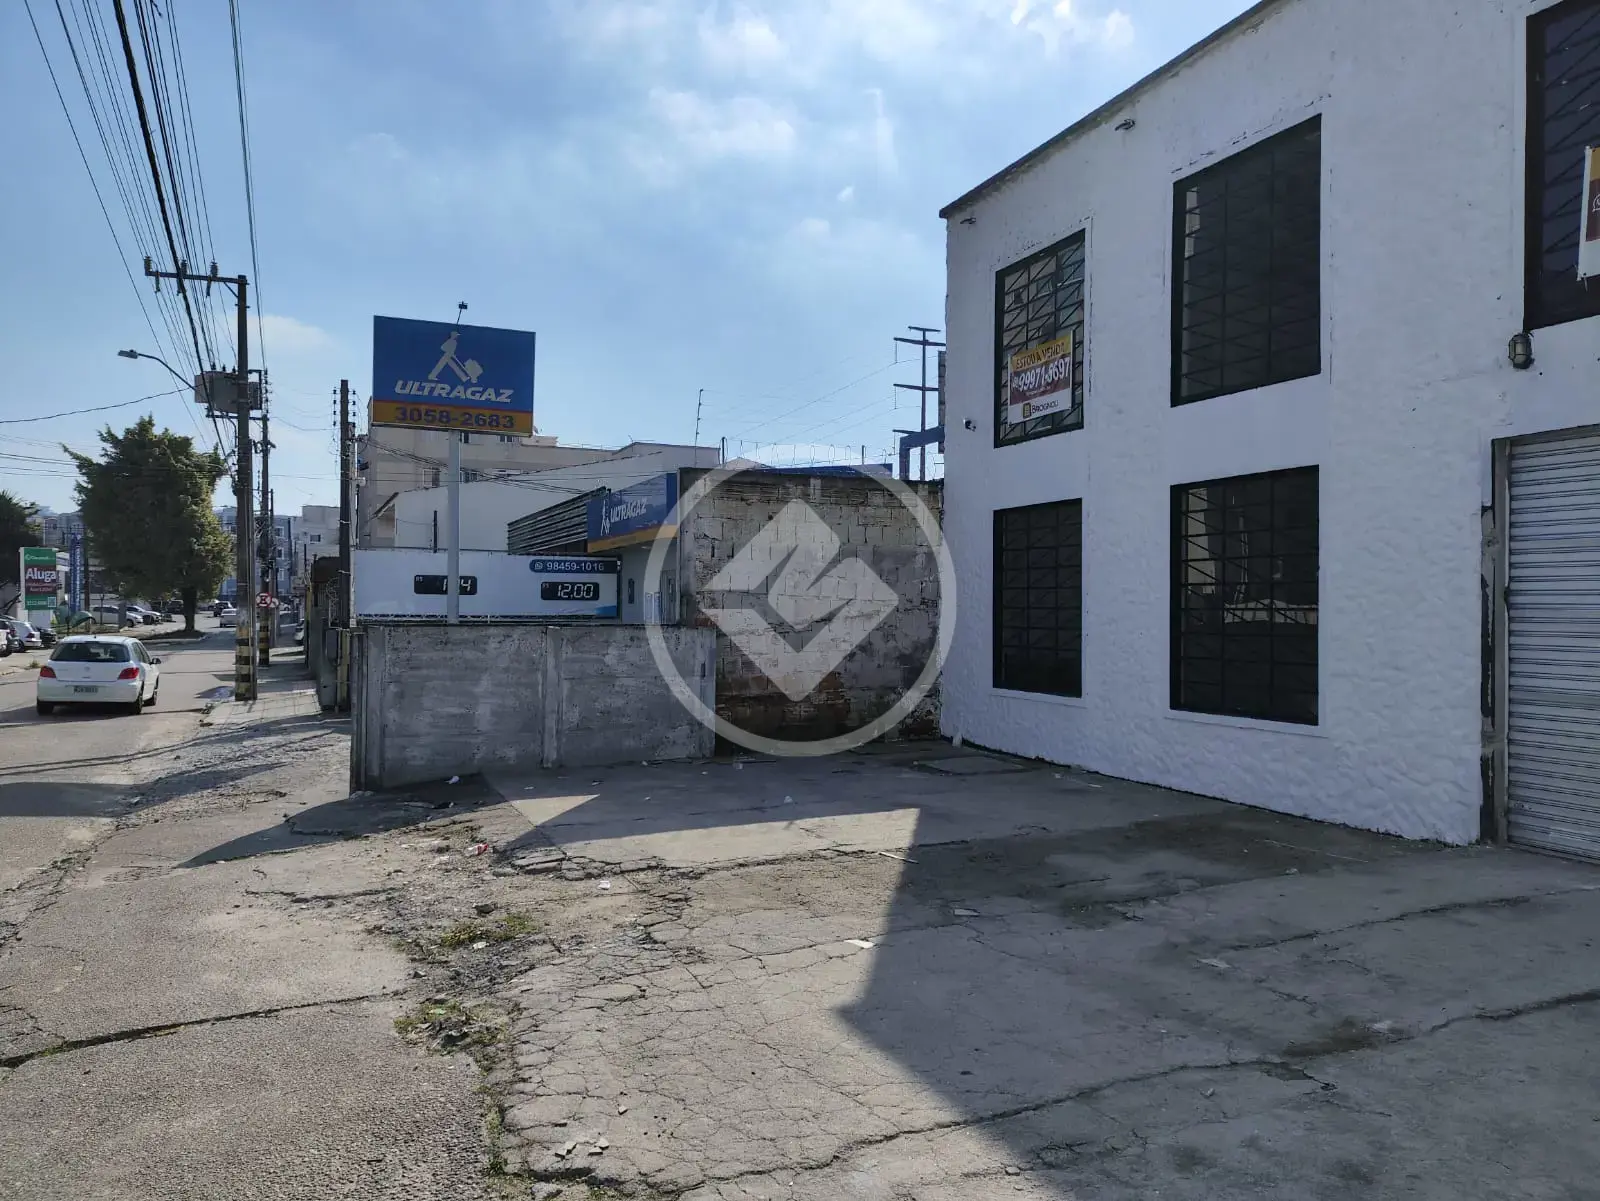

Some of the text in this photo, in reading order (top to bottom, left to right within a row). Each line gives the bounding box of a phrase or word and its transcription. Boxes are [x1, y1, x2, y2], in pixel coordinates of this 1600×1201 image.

[1016, 354, 1036, 369] ESTOU
[395, 380, 514, 403] ULTRAGAZ
[395, 406, 515, 429] 3058-2683
[610, 497, 648, 523] ULTRAGAZ
[546, 561, 605, 571] 98459-1016
[25, 567, 57, 583] Aluga
[557, 583, 594, 600] 12,00
